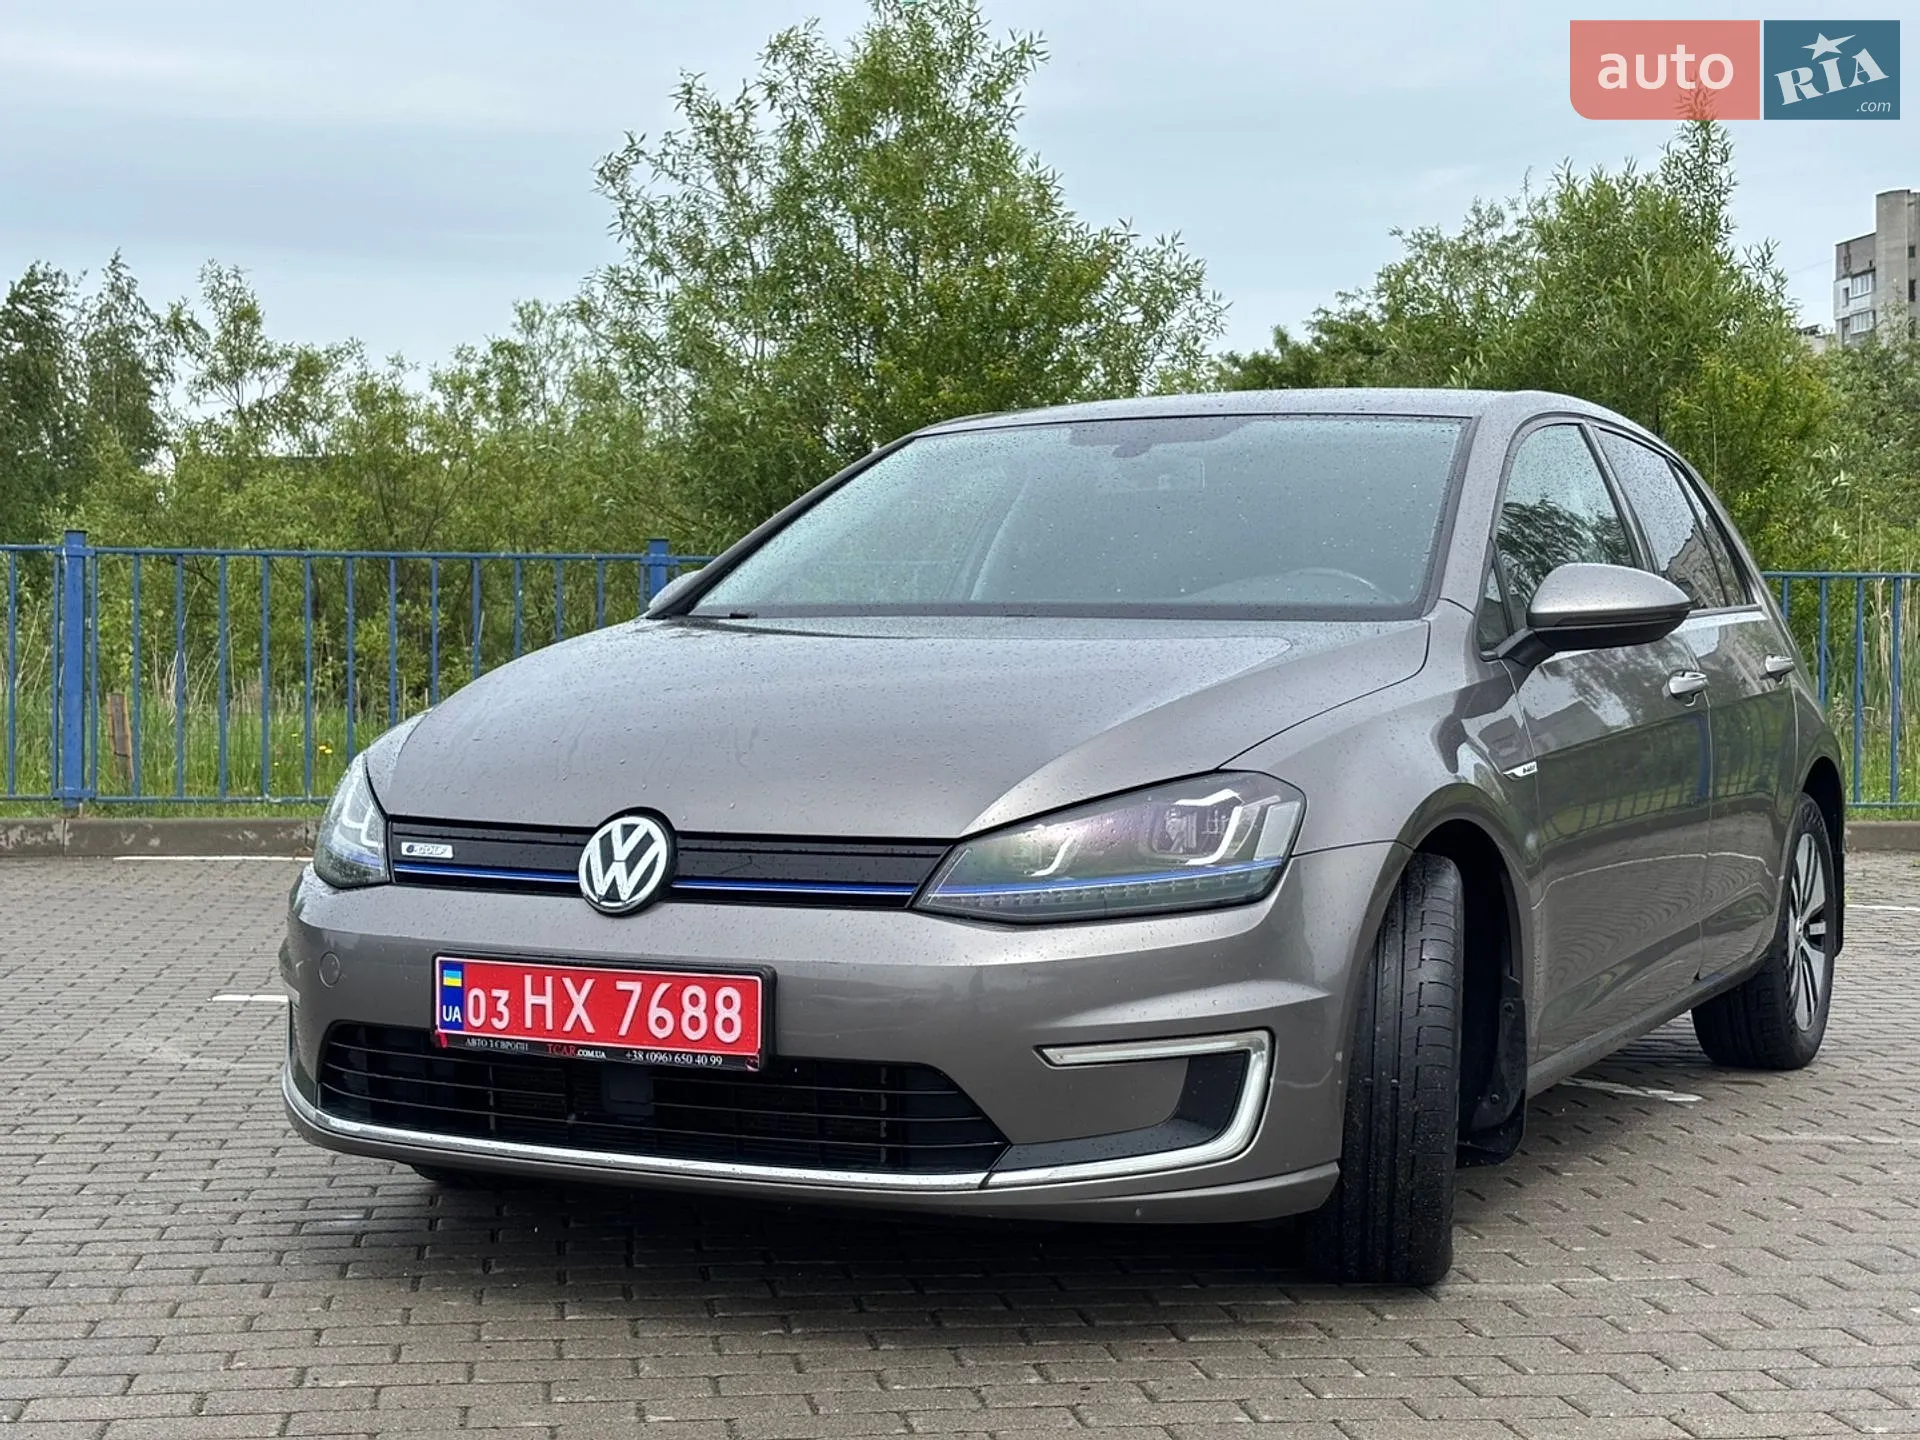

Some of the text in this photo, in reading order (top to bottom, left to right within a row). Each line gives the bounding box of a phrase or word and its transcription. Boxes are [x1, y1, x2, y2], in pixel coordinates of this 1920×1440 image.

[442, 1004, 463, 1024] UA
[467, 974, 742, 1044] 03 HX 7688
[625, 1049, 723, 1066] +38 (096) 650 40 99
